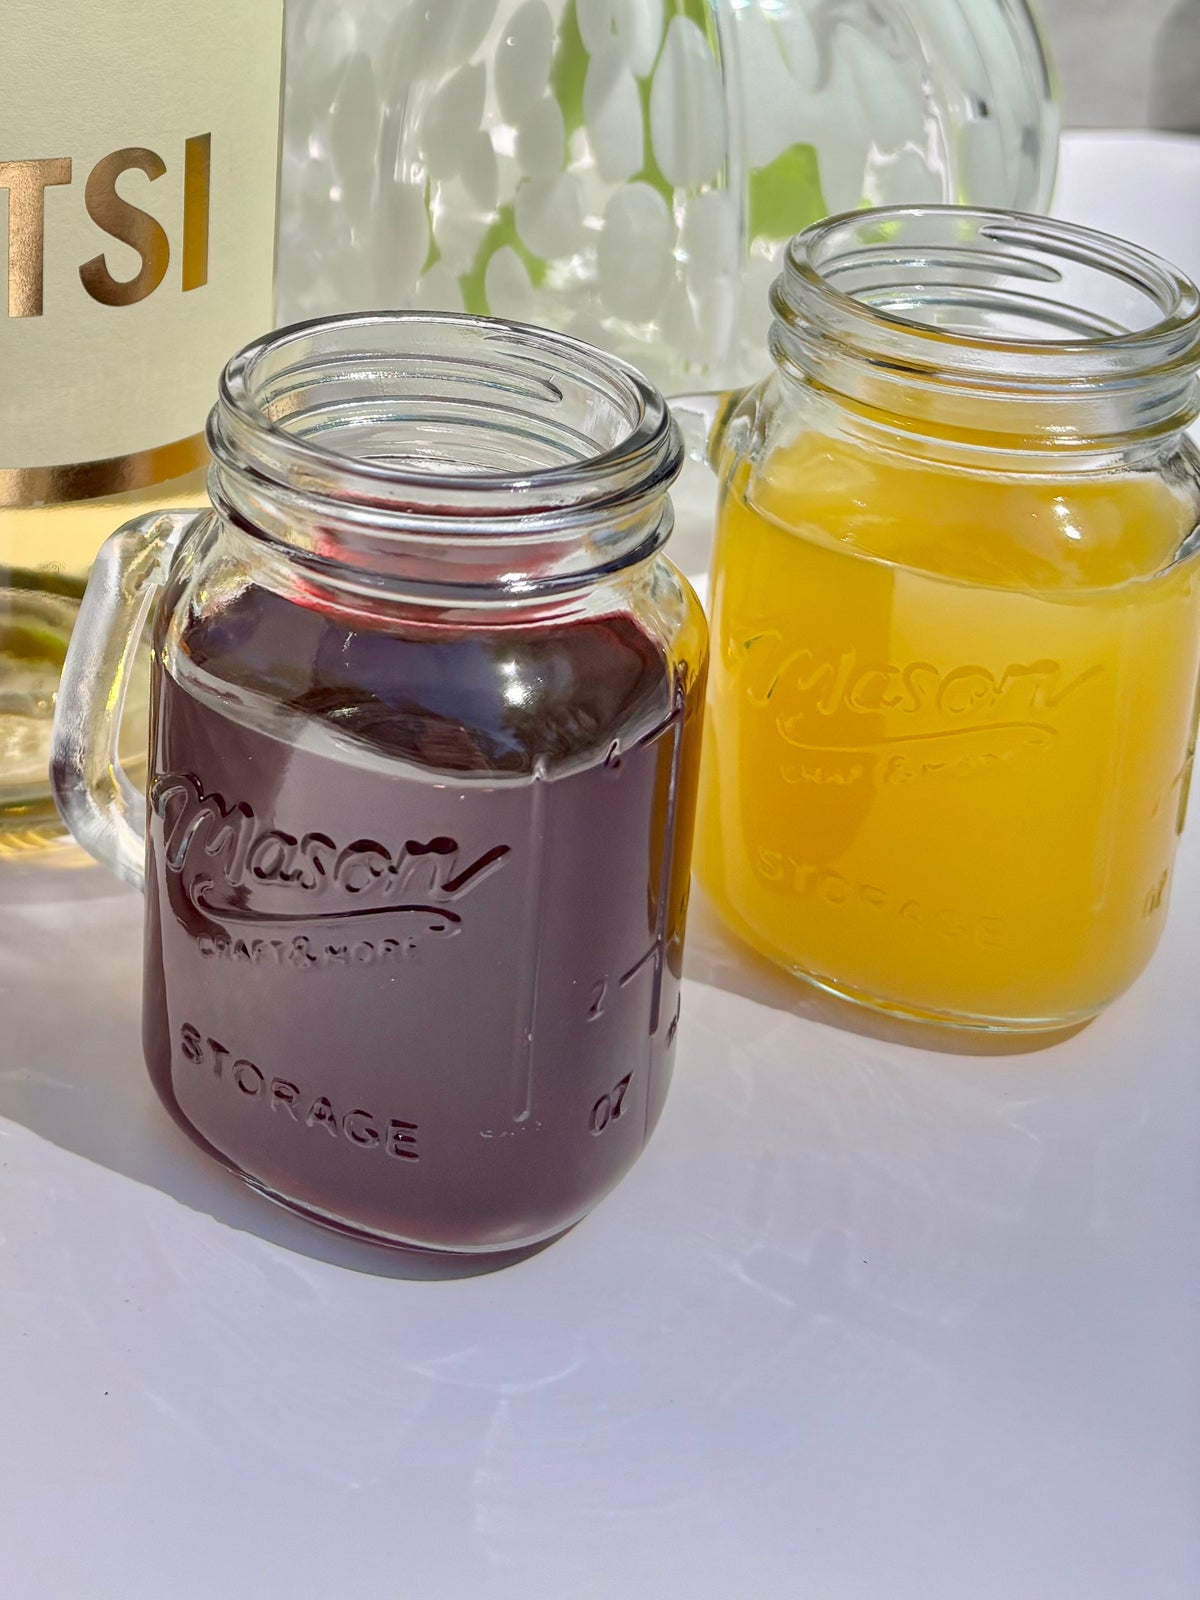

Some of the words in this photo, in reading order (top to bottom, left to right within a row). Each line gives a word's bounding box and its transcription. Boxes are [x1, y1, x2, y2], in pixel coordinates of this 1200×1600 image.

[730, 628, 1105, 716] Mason
[150, 773, 511, 903] Mason
[180, 1021, 420, 1163] STORAGE
